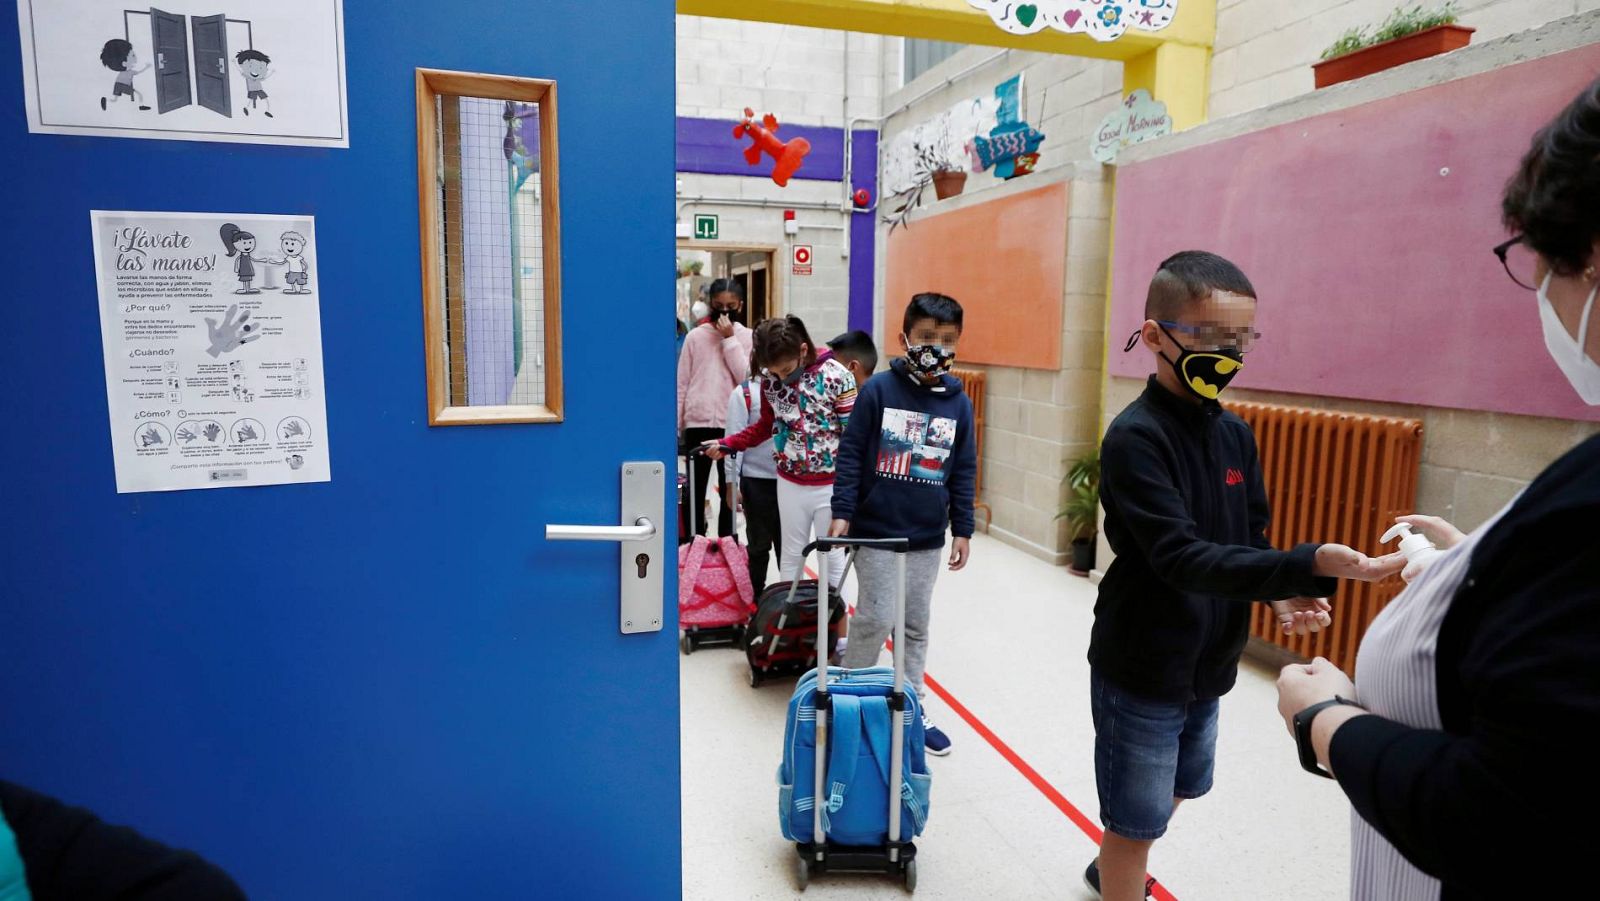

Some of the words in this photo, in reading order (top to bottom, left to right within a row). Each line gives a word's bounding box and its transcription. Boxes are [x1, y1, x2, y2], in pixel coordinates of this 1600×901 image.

[114, 226, 193, 256] ¡Lávate
[116, 253, 145, 271] las
[152, 253, 217, 271] manos!
[125, 304, 146, 312] ¿Por
[148, 304, 171, 312] qué?
[129, 348, 175, 358] ¿Cuándo?
[134, 410, 171, 420] ¿Cómo?
[876, 472, 913, 482] TIMELESS
